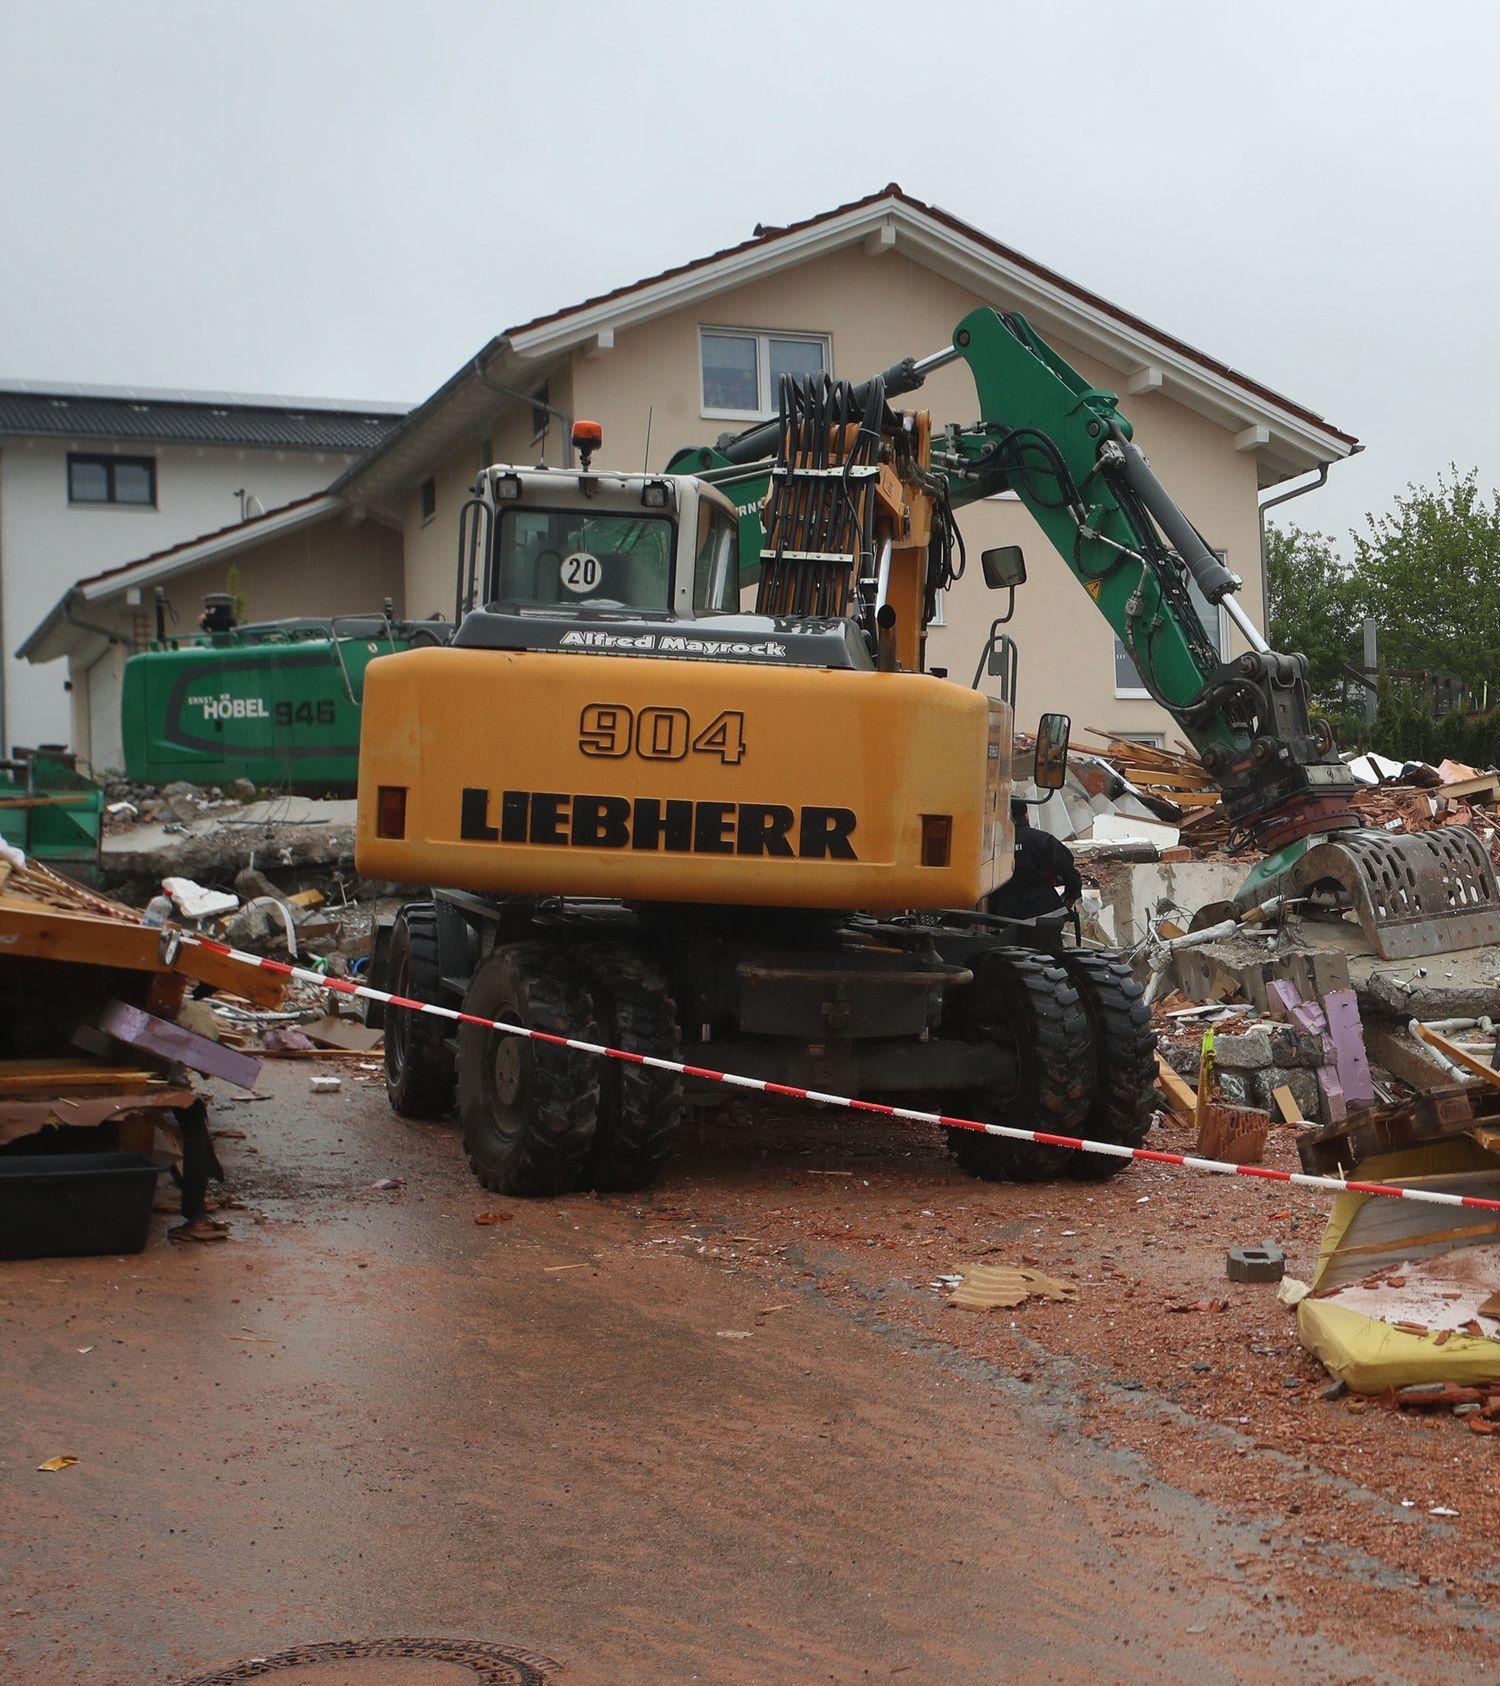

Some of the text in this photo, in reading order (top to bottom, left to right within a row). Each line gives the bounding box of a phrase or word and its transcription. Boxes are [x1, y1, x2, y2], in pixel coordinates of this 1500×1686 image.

[568, 558, 596, 585] 20
[559, 630, 786, 657] Alfred Mayrock
[204, 693, 269, 720] HÖBEL
[578, 702, 747, 765] 904
[460, 787, 858, 861] LIEBHERR
